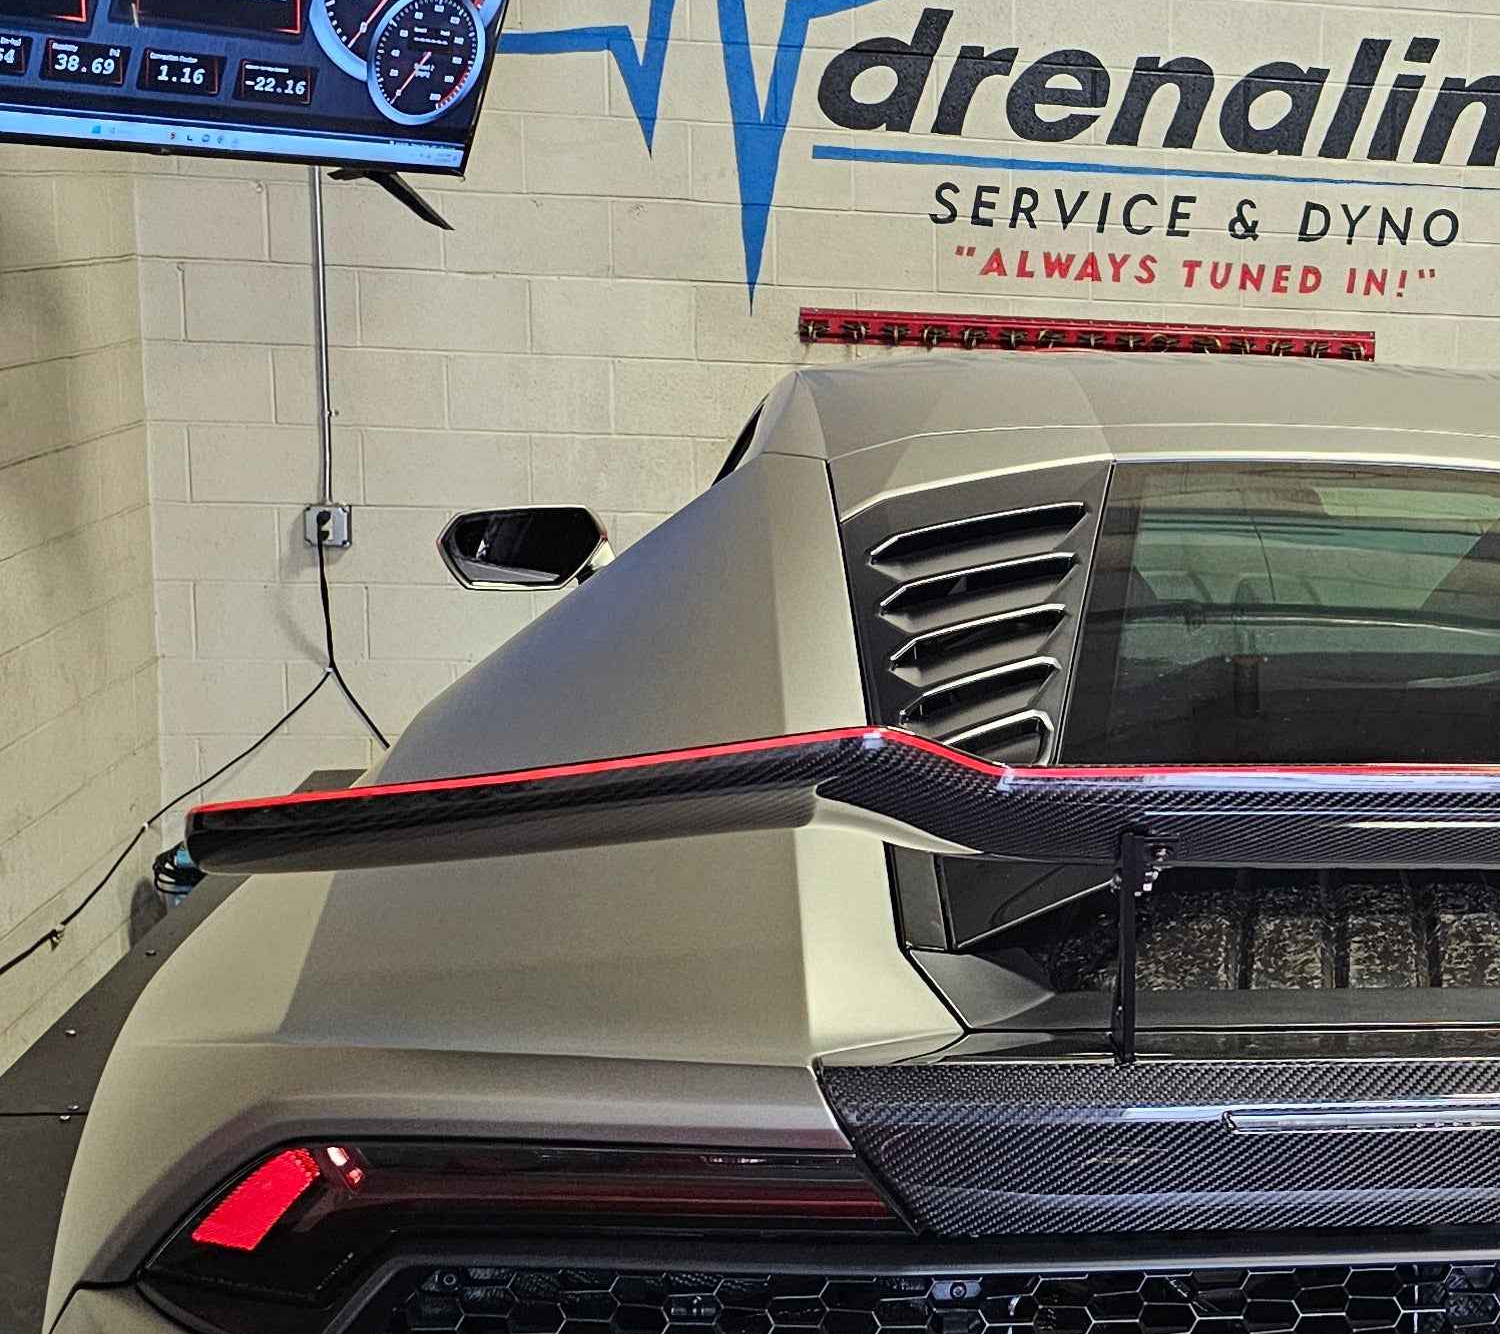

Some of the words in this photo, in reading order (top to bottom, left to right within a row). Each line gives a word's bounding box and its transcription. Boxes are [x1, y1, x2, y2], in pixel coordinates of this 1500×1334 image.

[54, 53, 115, 75] 38.69
[157, 64, 206, 85] 1.16
[245, 76, 307, 95] -22.16
[929, 182, 1198, 239] SERVICE
[1228, 199, 1260, 242] &
[1298, 201, 1461, 247] DYNO
[954, 246, 1158, 286] "ALWAYS
[1183, 259, 1323, 294] TUNED
[1346, 267, 1438, 298] IN!"
